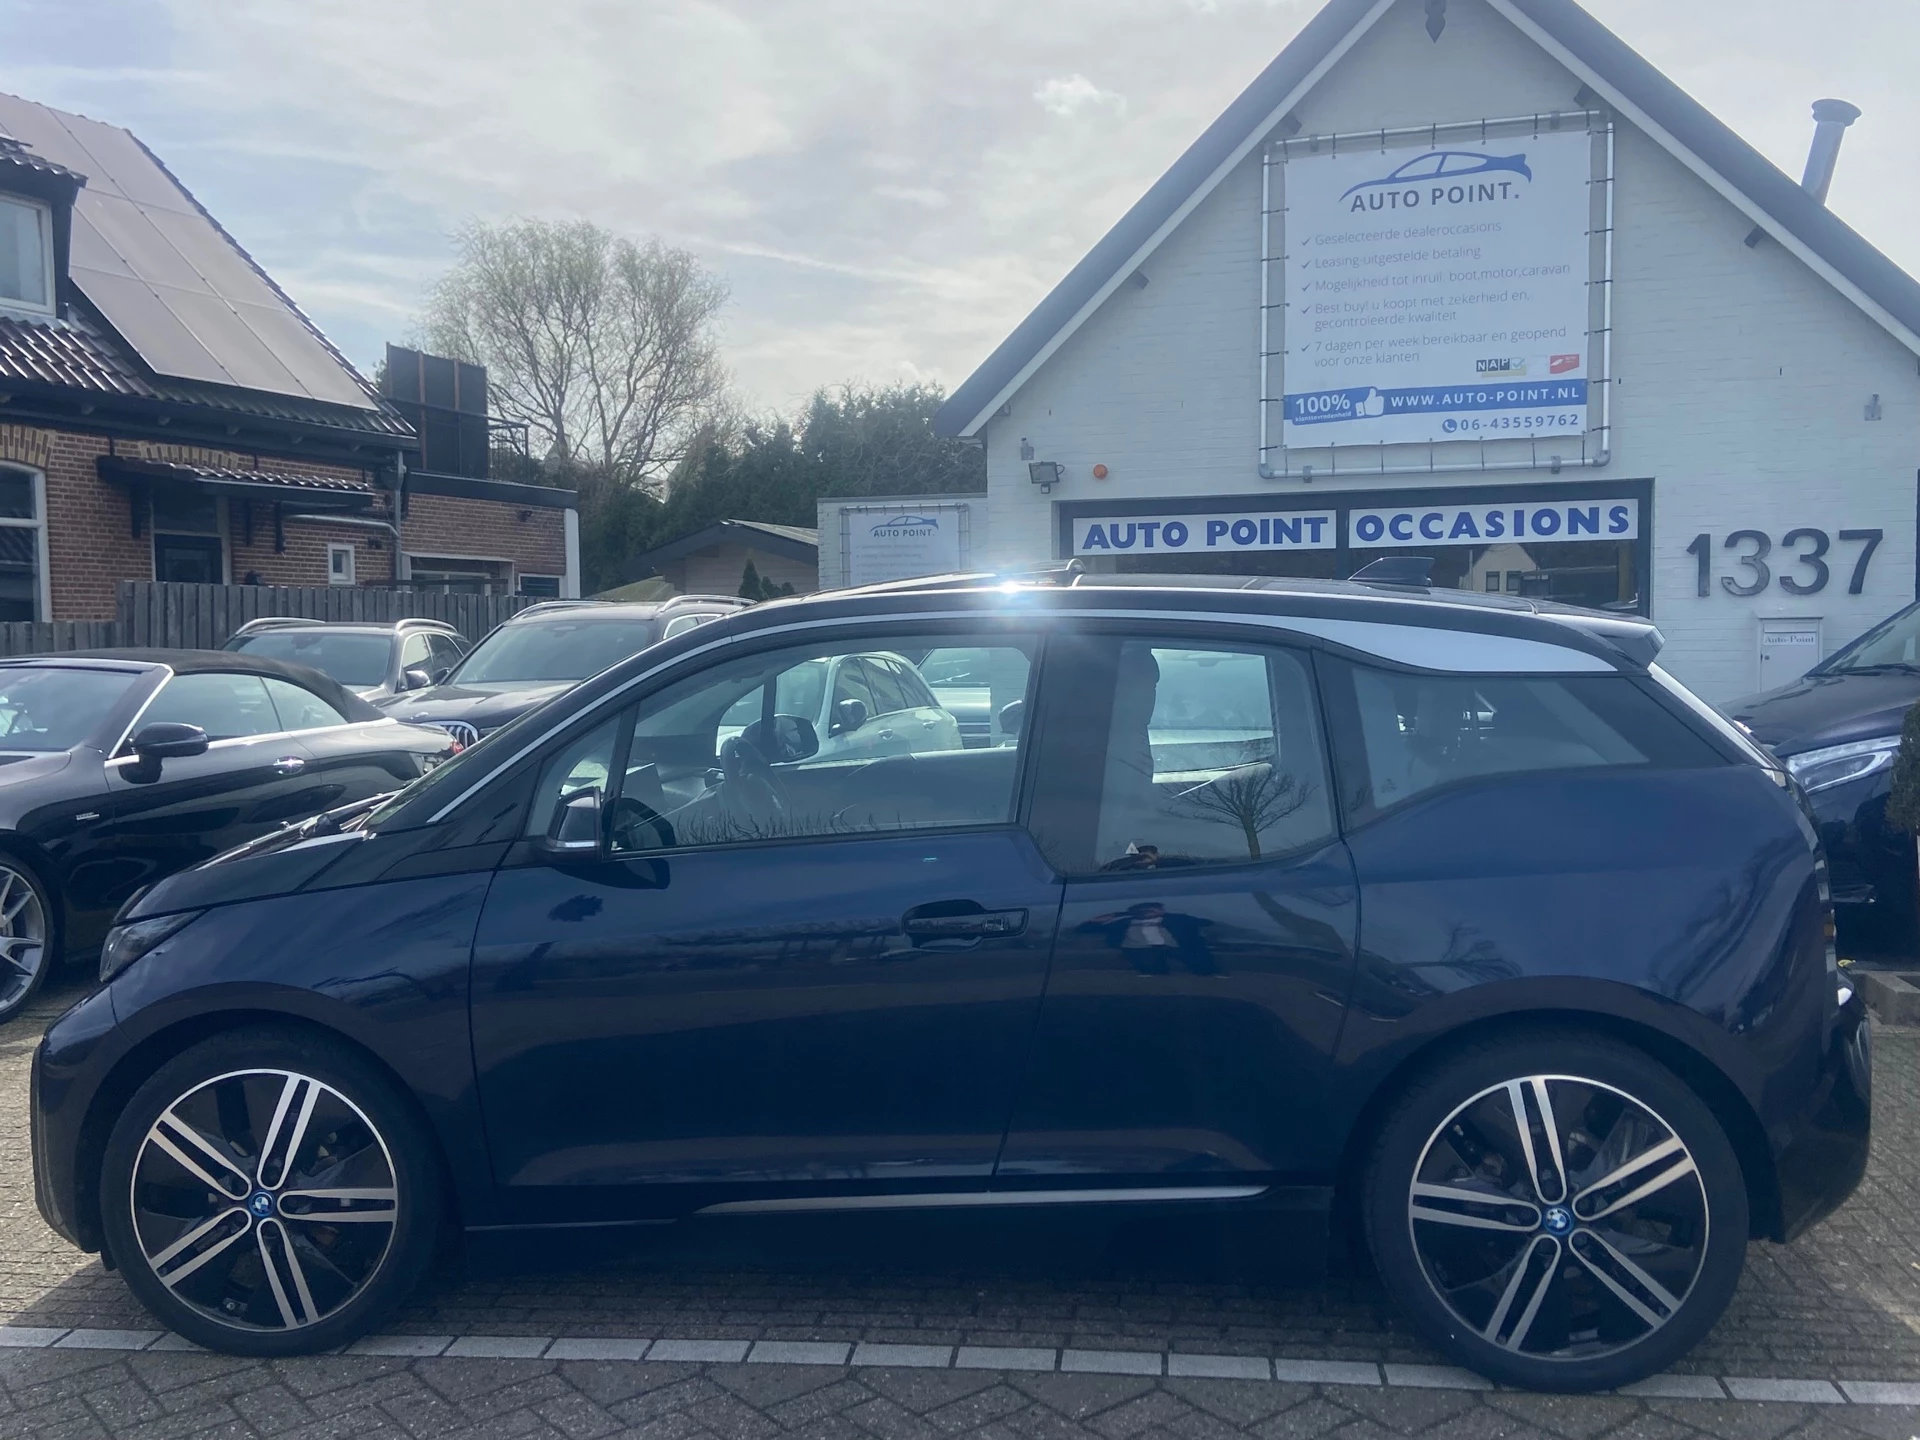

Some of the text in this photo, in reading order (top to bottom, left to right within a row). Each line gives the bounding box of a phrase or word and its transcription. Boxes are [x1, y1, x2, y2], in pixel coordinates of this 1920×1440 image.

[1350, 181, 1520, 213] AUTO POINT.
[1315, 221, 1502, 246] Geselecteerde dealeroccasions
[1432, 247, 1481, 260] betaling
[1315, 277, 1389, 293] Mogelijkheid
[1392, 275, 1409, 286] tot
[1315, 302, 1341, 314] Best
[1372, 301, 1380, 311] u
[1383, 298, 1417, 310] koopt
[1421, 297, 1444, 307] met
[1448, 291, 1508, 306] zekerheid
[1314, 311, 1457, 333] gecontroleerde kwaliteit
[1314, 326, 1567, 353] 7 dagen per week bereikbaar en geopend
[1314, 352, 1420, 367] voor onze klanten
[1477, 358, 1509, 371] NAP
[1296, 393, 1351, 415] 100%
[1391, 387, 1579, 408] WWW.AUTO-POINT.NL
[1460, 413, 1579, 431] 06-43559762
[873, 529, 900, 538] AUTO
[1082, 516, 1328, 549] AUTO POINT
[1356, 506, 1629, 542] OCCASIONS
[1686, 528, 1884, 597] 1337
